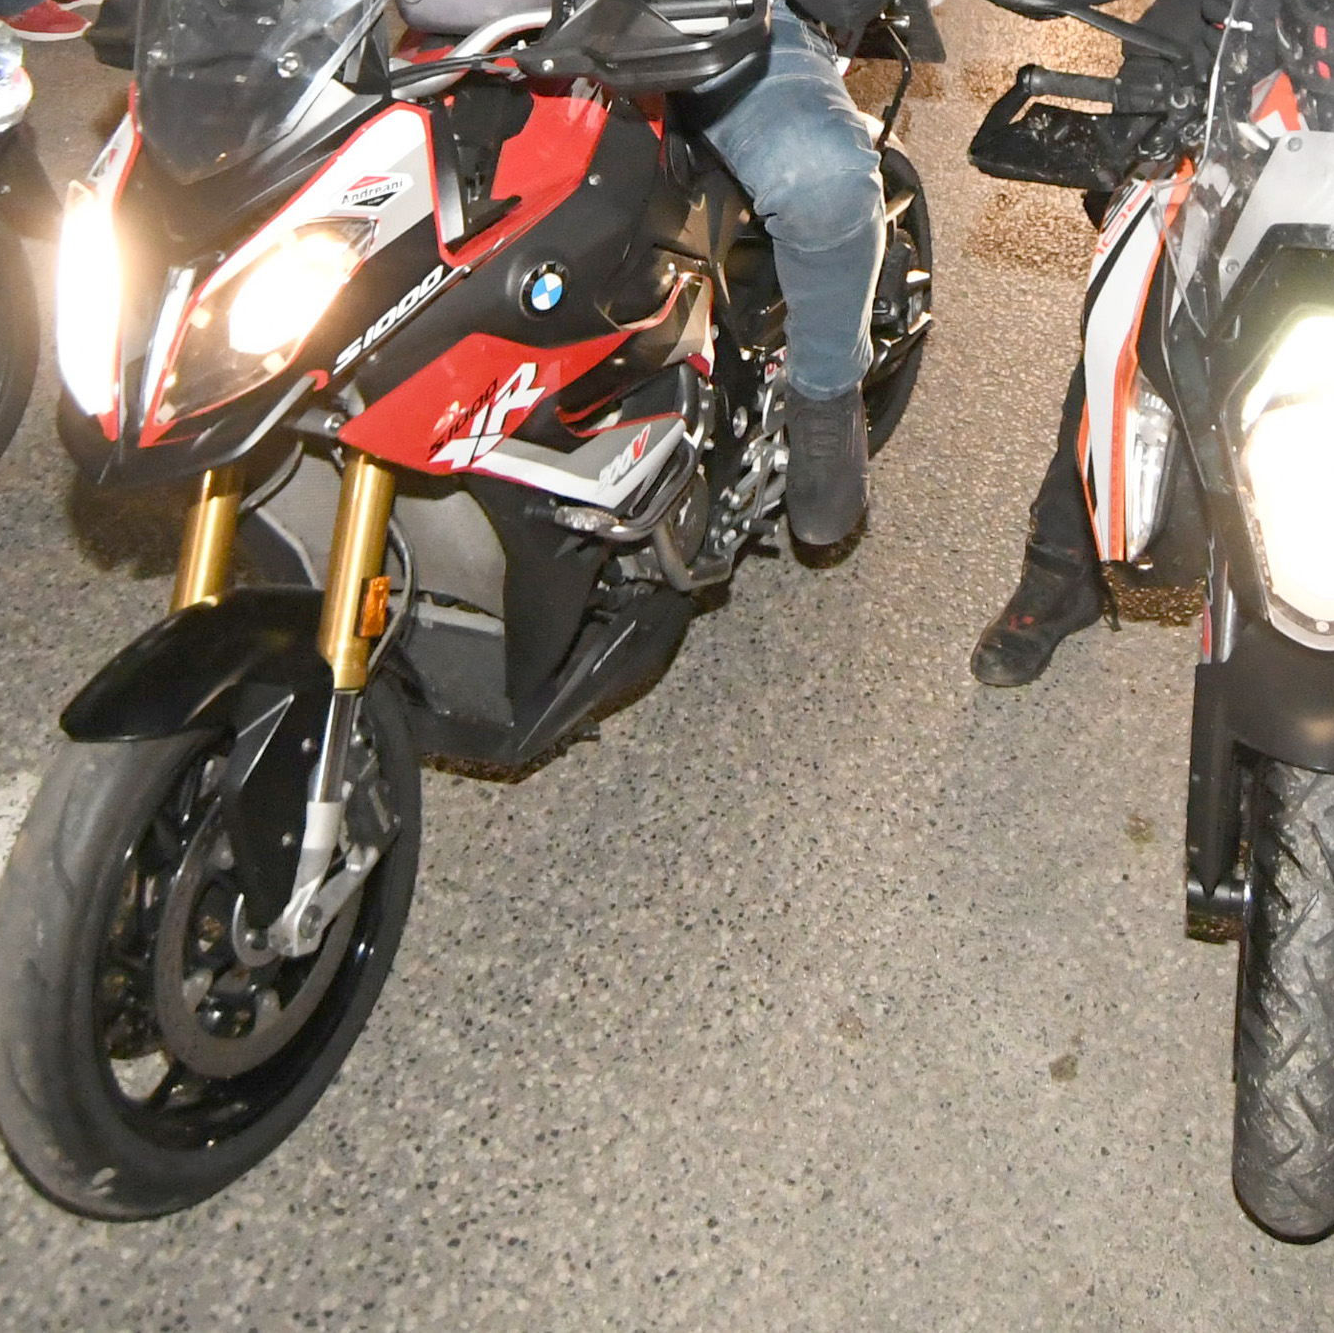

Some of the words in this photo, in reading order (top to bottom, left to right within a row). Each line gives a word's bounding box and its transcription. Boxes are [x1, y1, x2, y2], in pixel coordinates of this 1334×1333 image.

[341, 178, 403, 205] Andreani
[332, 265, 445, 376] S1000
[428, 362, 547, 471] XR
